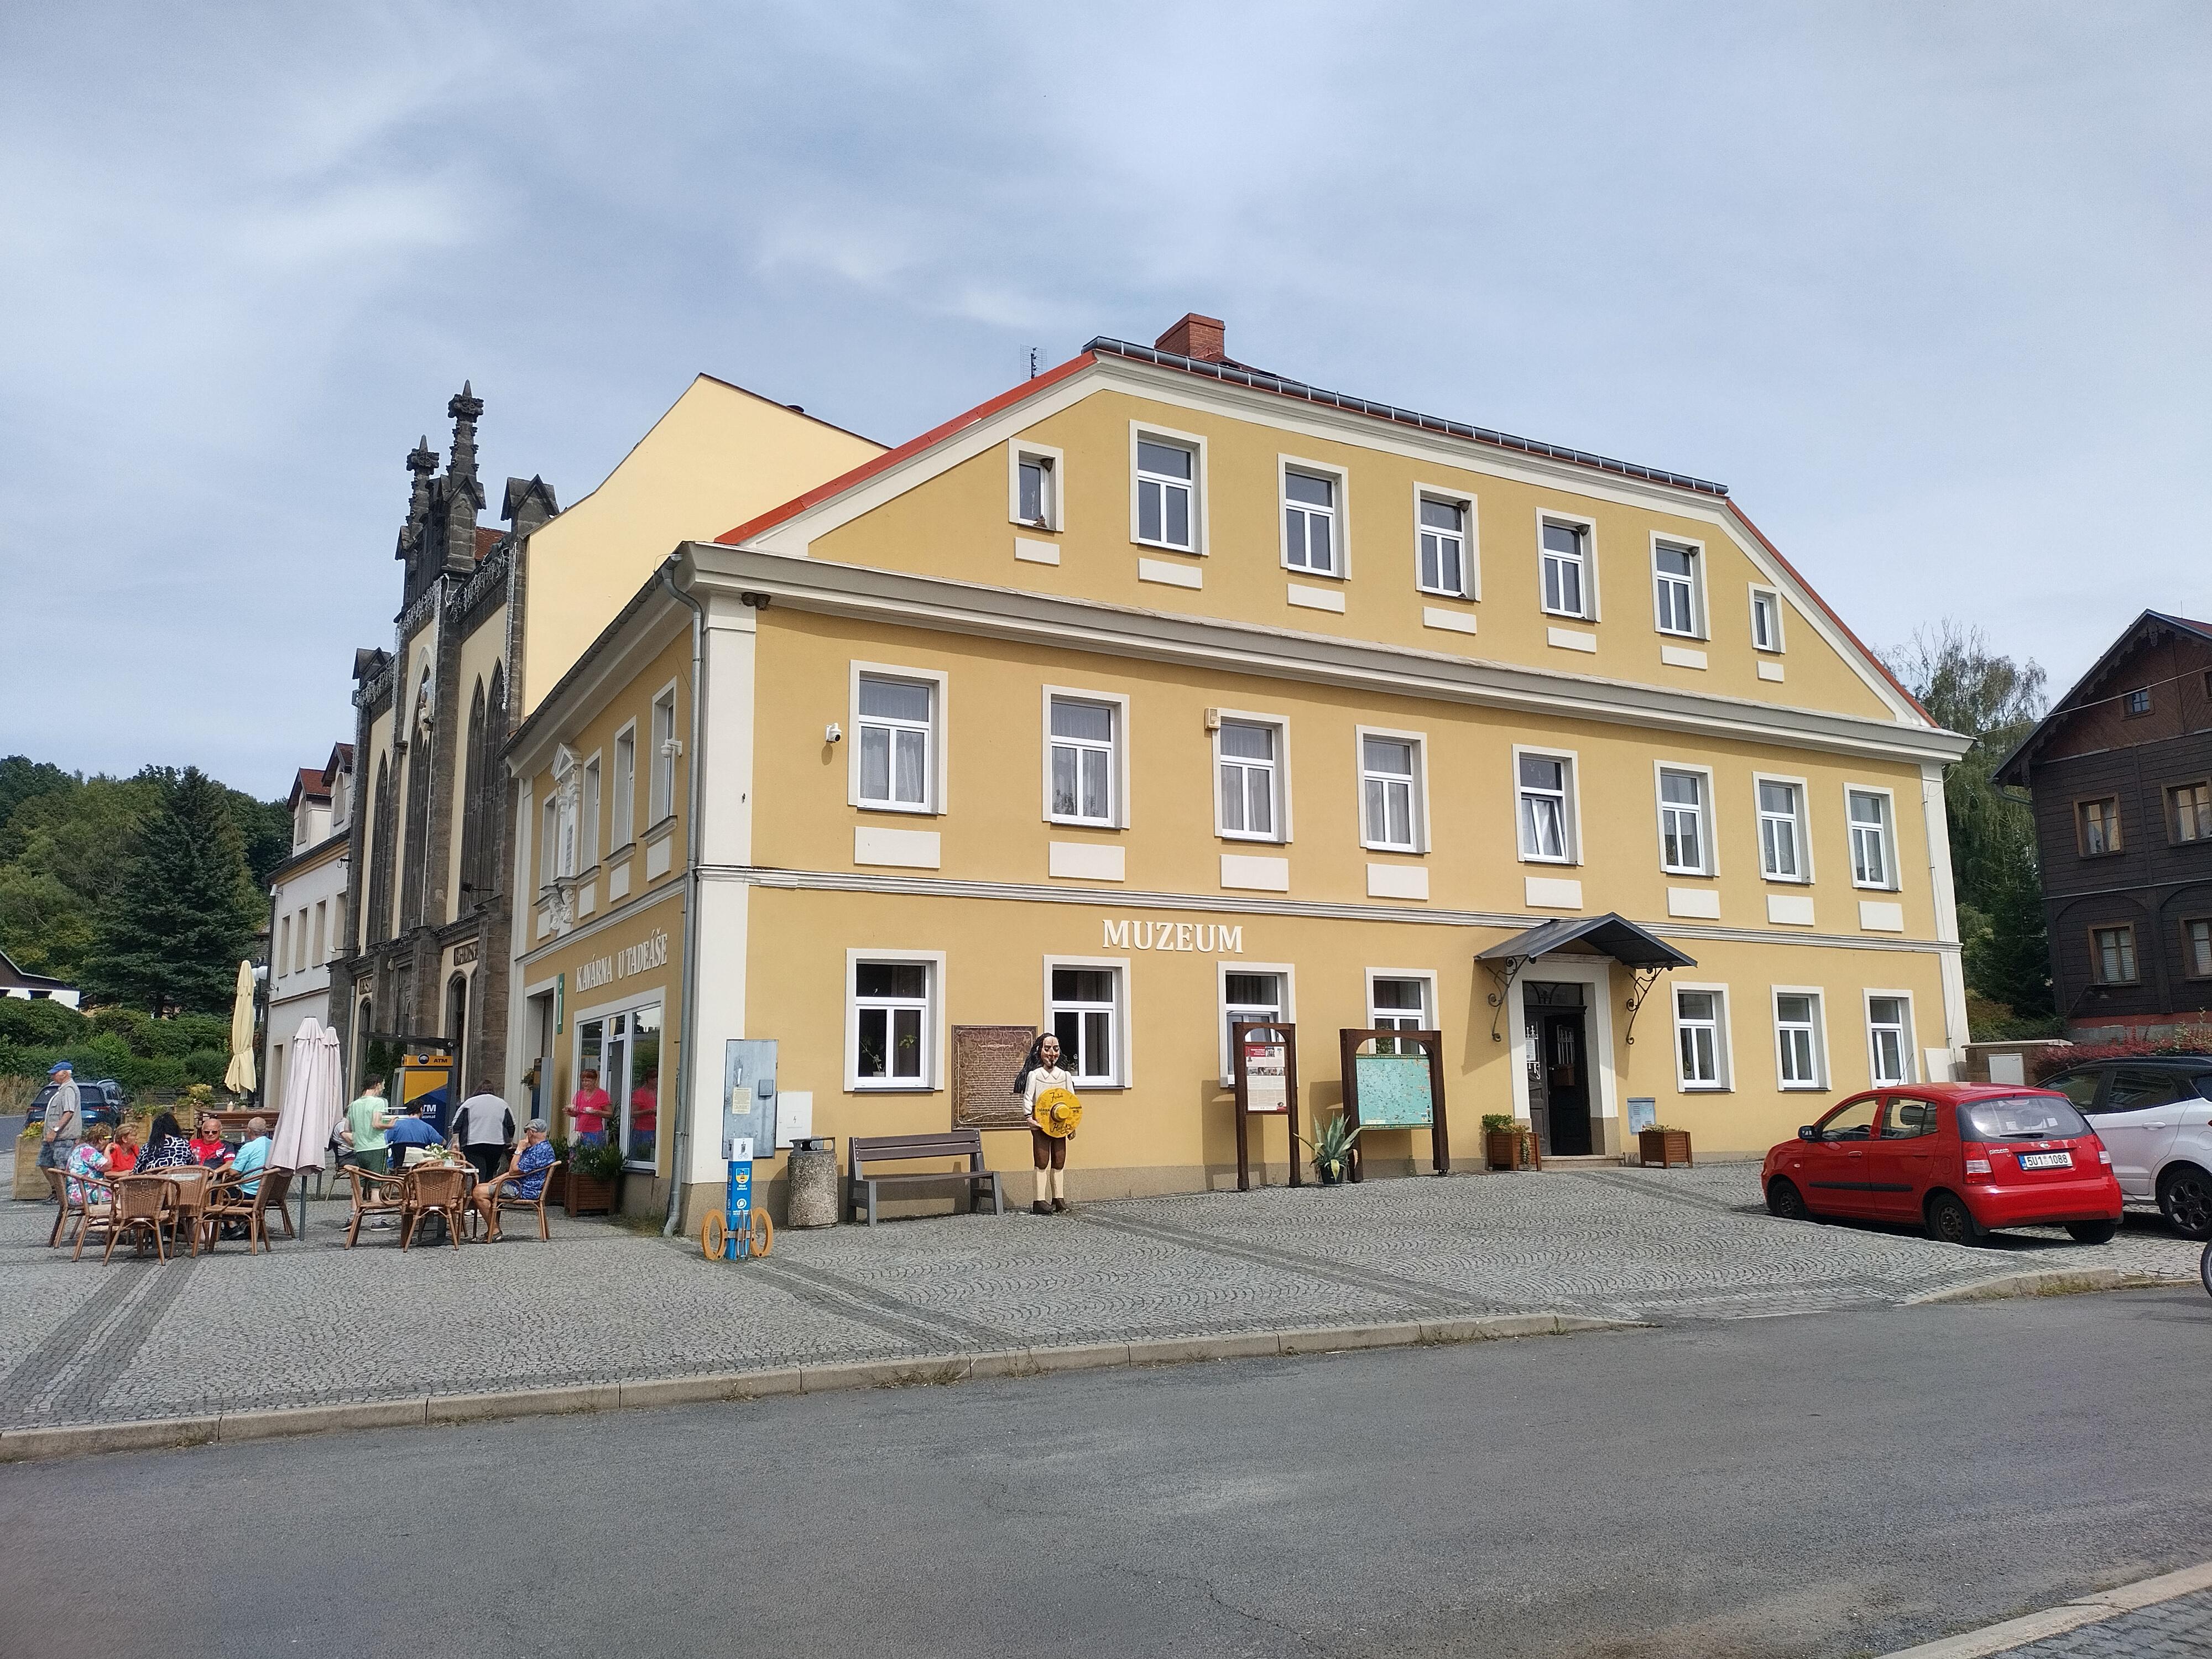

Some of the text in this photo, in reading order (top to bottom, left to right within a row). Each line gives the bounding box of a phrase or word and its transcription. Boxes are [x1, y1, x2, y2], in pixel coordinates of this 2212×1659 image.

[1102, 919, 1244, 953] MUZEUM
[576, 927, 668, 993] KAVÁRNA U TADEÁŠE
[2027, 1156, 2043, 1166] 5U1
[2049, 1154, 2068, 1164] 1088
